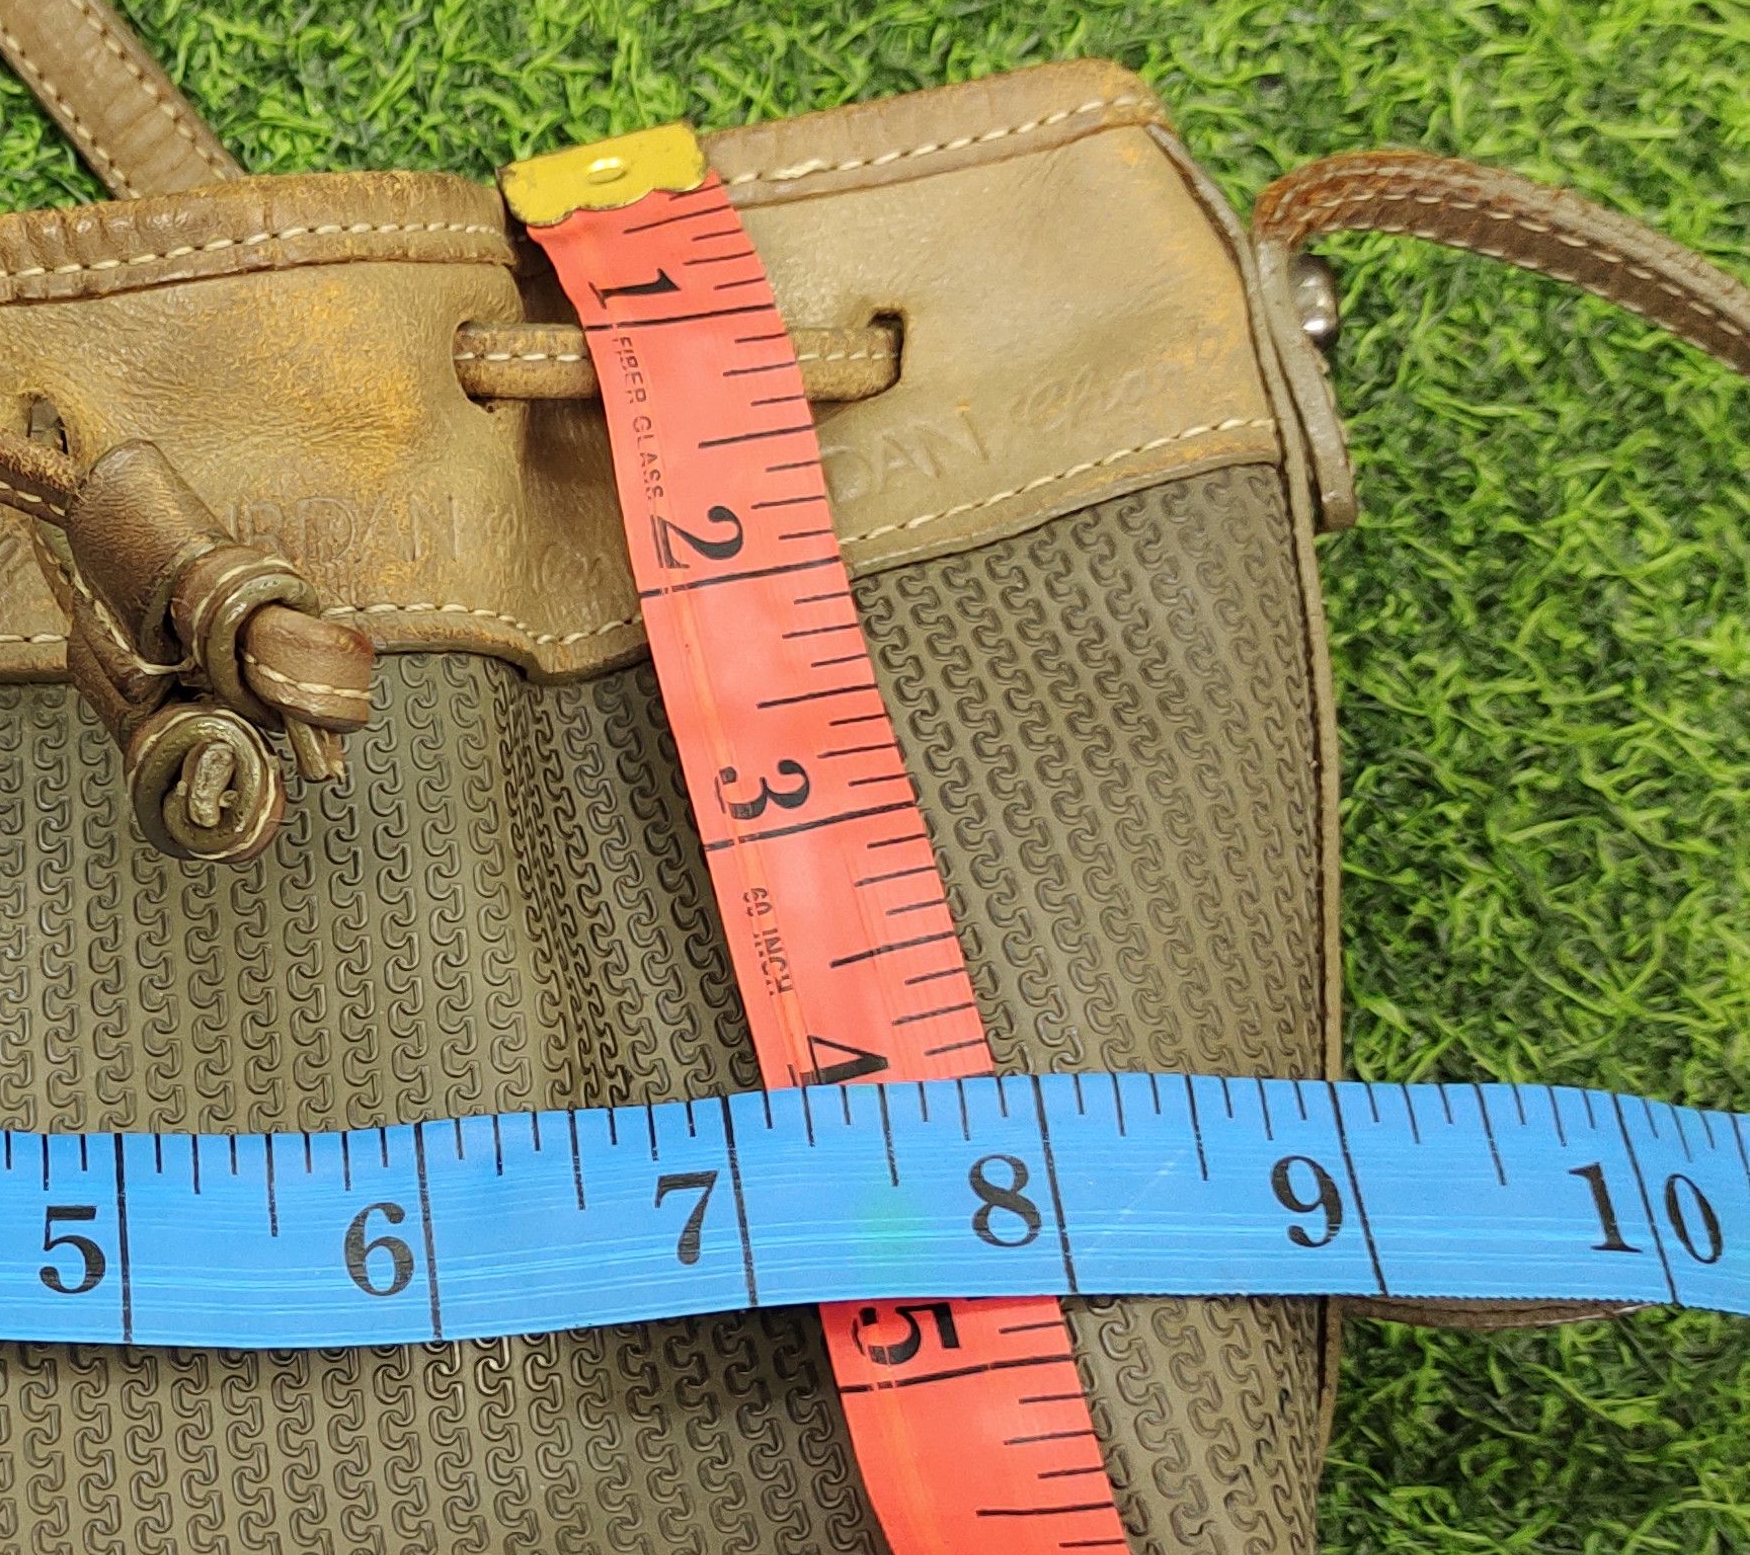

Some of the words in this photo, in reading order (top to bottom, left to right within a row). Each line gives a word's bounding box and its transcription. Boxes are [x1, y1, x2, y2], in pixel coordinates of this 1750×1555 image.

[588, 268, 681, 311] 1
[650, 505, 744, 571] 2
[714, 758, 811, 821] 3
[654, 1169, 719, 1266] 7
[967, 1153, 1044, 1248] 8
[1270, 1154, 1344, 1249] 9
[1568, 1161, 1725, 1265] 10
[38, 1204, 107, 1295] 5
[343, 1201, 415, 1297] 6
[852, 1301, 961, 1367] 5
